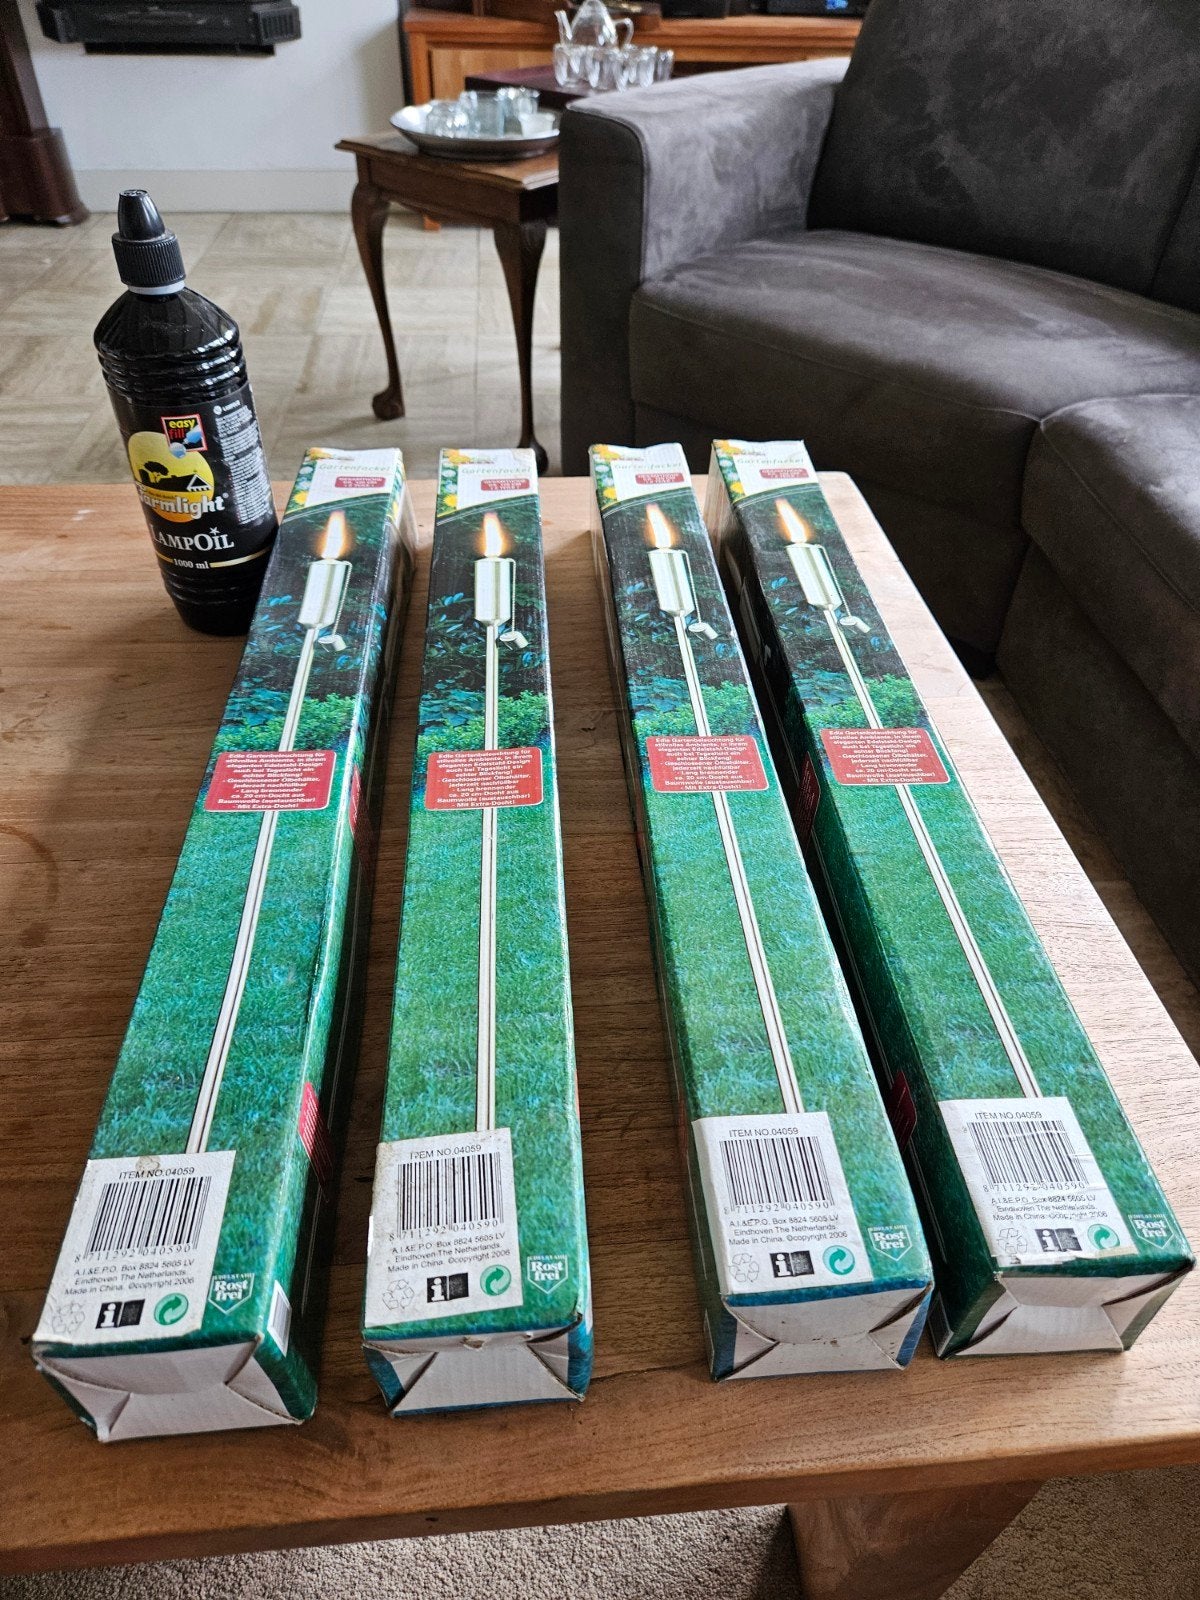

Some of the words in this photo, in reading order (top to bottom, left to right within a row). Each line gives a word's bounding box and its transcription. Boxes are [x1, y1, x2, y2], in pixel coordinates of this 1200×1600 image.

[169, 419, 195, 430] easy
[168, 428, 185, 440] fill
[174, 559, 193, 569] 1000
[196, 561, 209, 569] ml
[729, 1129, 752, 1137] ITEM
[119, 1170, 144, 1180] ITEM
[1133, 1220, 1167, 1229] Rost
[495, 1232, 506, 1240] LV
[734, 1228, 773, 1236] Eindhoven
[873, 1230, 907, 1241] Rost
[1142, 1228, 1167, 1237] frei
[729, 1238, 749, 1246] Made
[880, 1239, 905, 1250] frei
[387, 1264, 409, 1273] Made
[491, 1249, 510, 1258] 2006
[395, 1252, 436, 1263] Eindhoven
[531, 1261, 564, 1272] Rost
[74, 1276, 117, 1285] Eindhoven
[534, 1270, 560, 1281] frei
[174, 1277, 194, 1285] 2006
[215, 1280, 248, 1291] Rost
[216, 1289, 243, 1301] frei
